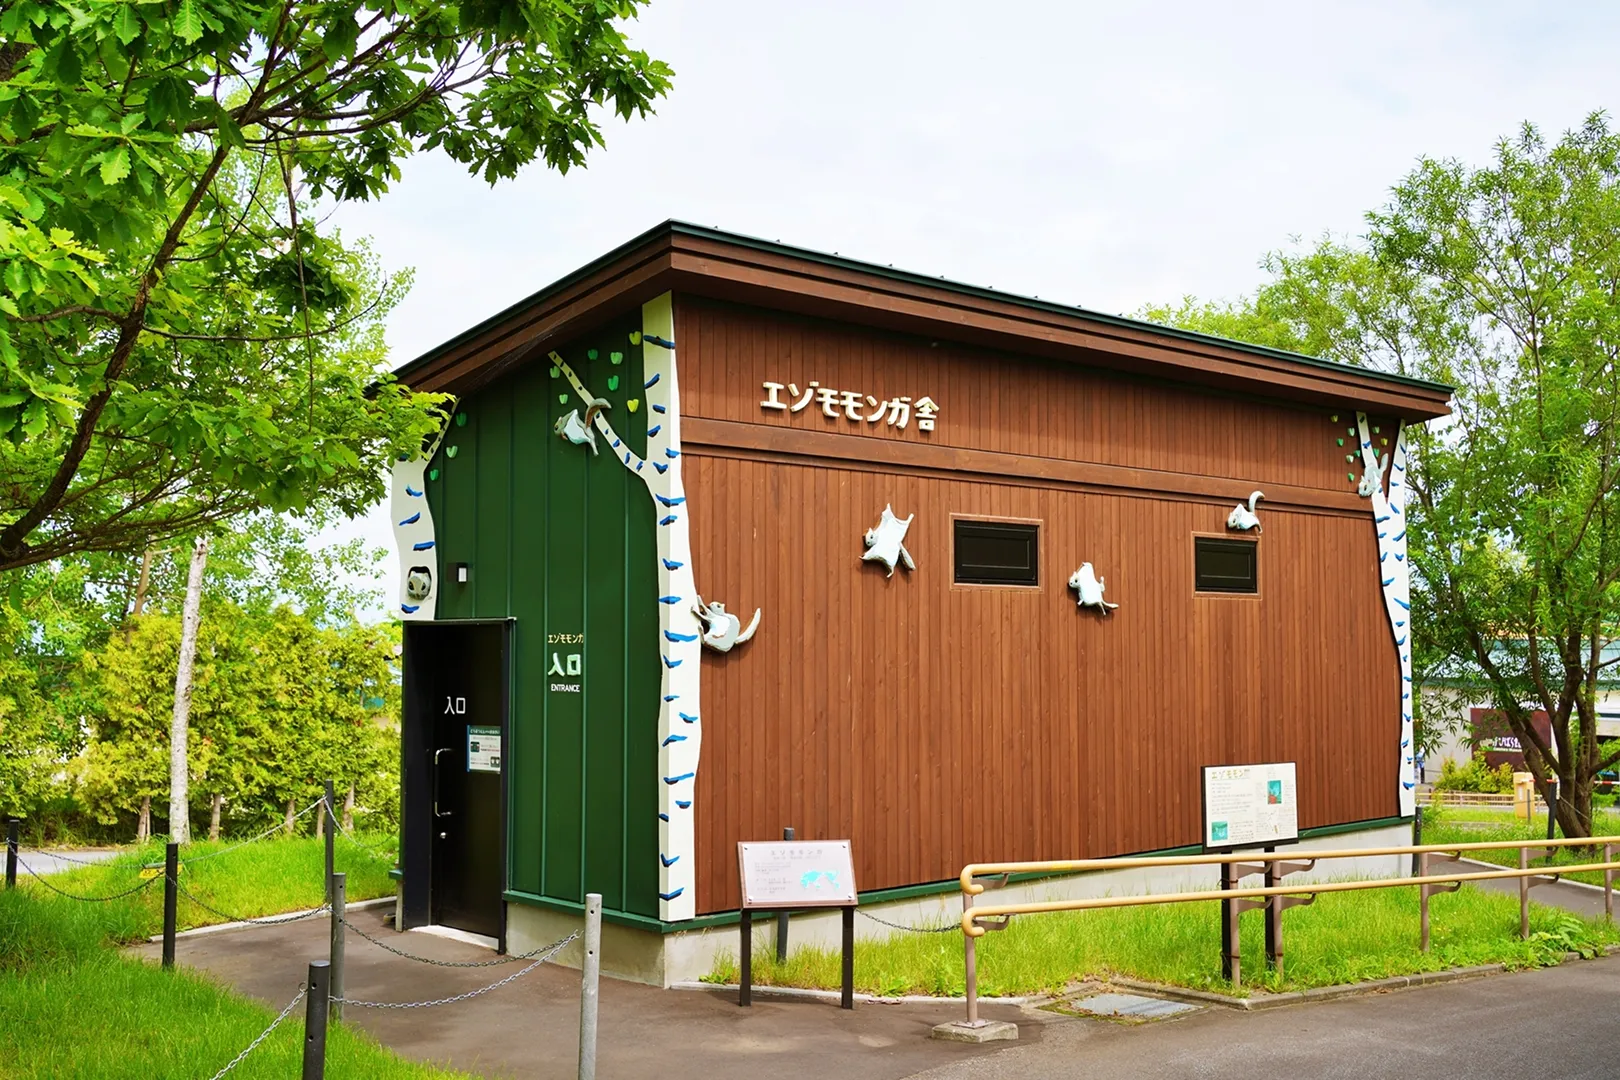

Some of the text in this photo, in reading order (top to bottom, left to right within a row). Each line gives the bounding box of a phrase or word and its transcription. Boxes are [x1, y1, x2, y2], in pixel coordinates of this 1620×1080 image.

[760, 381, 940, 431] エゾモモンガ舎
[548, 652, 581, 677] 入口
[551, 683, 580, 693] ENTRANCE
[444, 696, 466, 715] 入口
